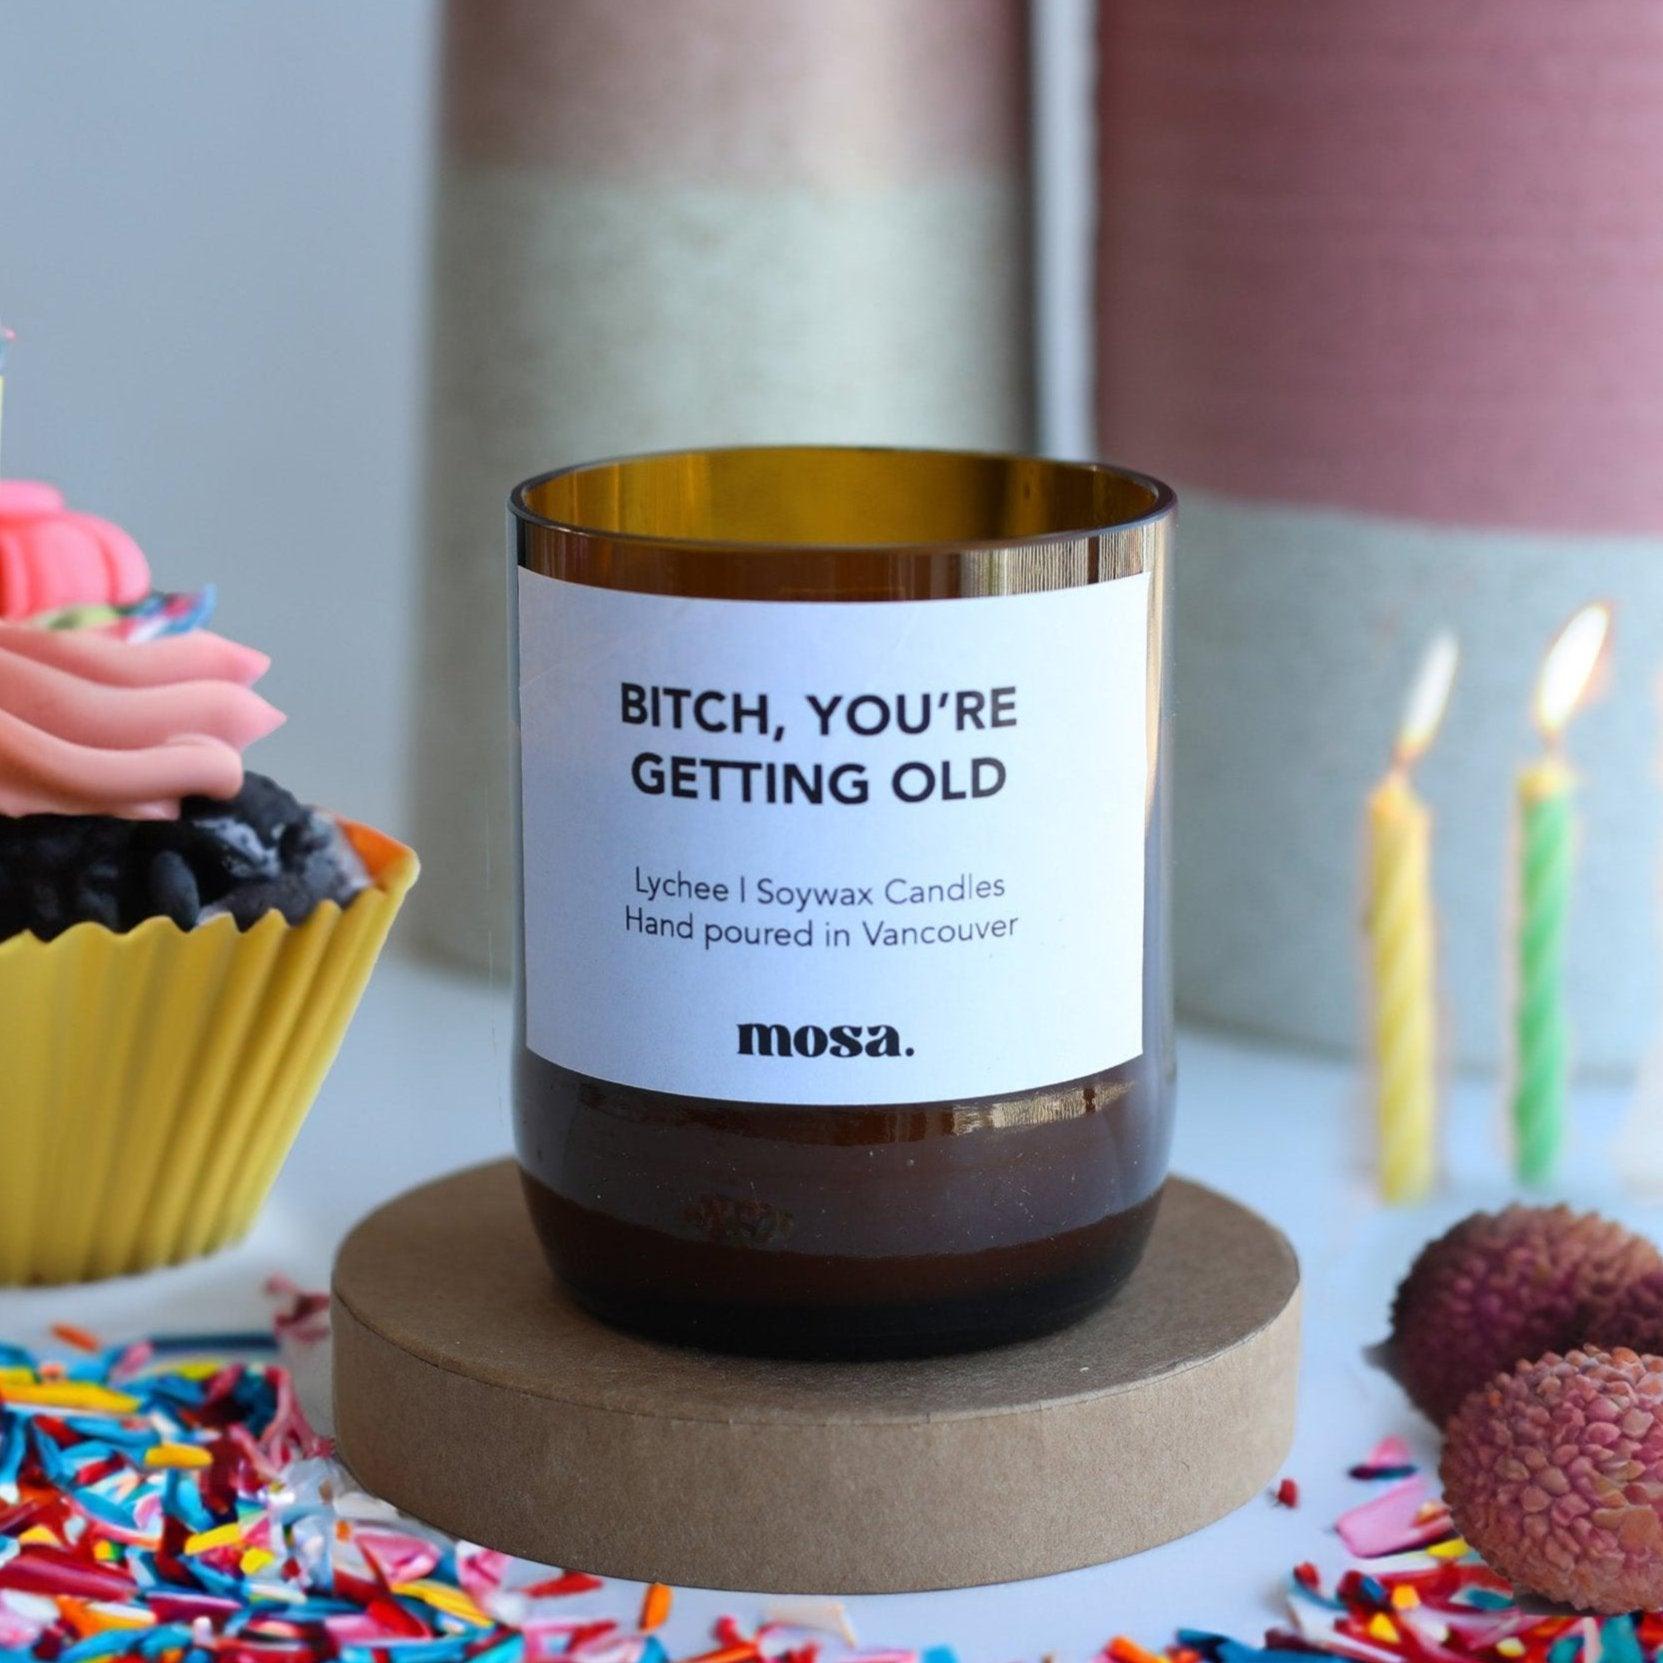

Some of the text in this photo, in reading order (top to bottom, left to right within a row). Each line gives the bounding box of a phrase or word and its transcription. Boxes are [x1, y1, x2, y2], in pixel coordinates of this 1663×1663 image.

[620, 681, 1018, 743] BITCH, YOU'RE
[630, 751, 1007, 806] GETTING OLD
[635, 865, 731, 903] Lychee
[756, 877, 874, 913] Soywax
[884, 873, 1006, 905] Candles
[625, 904, 1019, 951] Hand poured in Vancouver
[736, 1022, 916, 1059] mosa.
